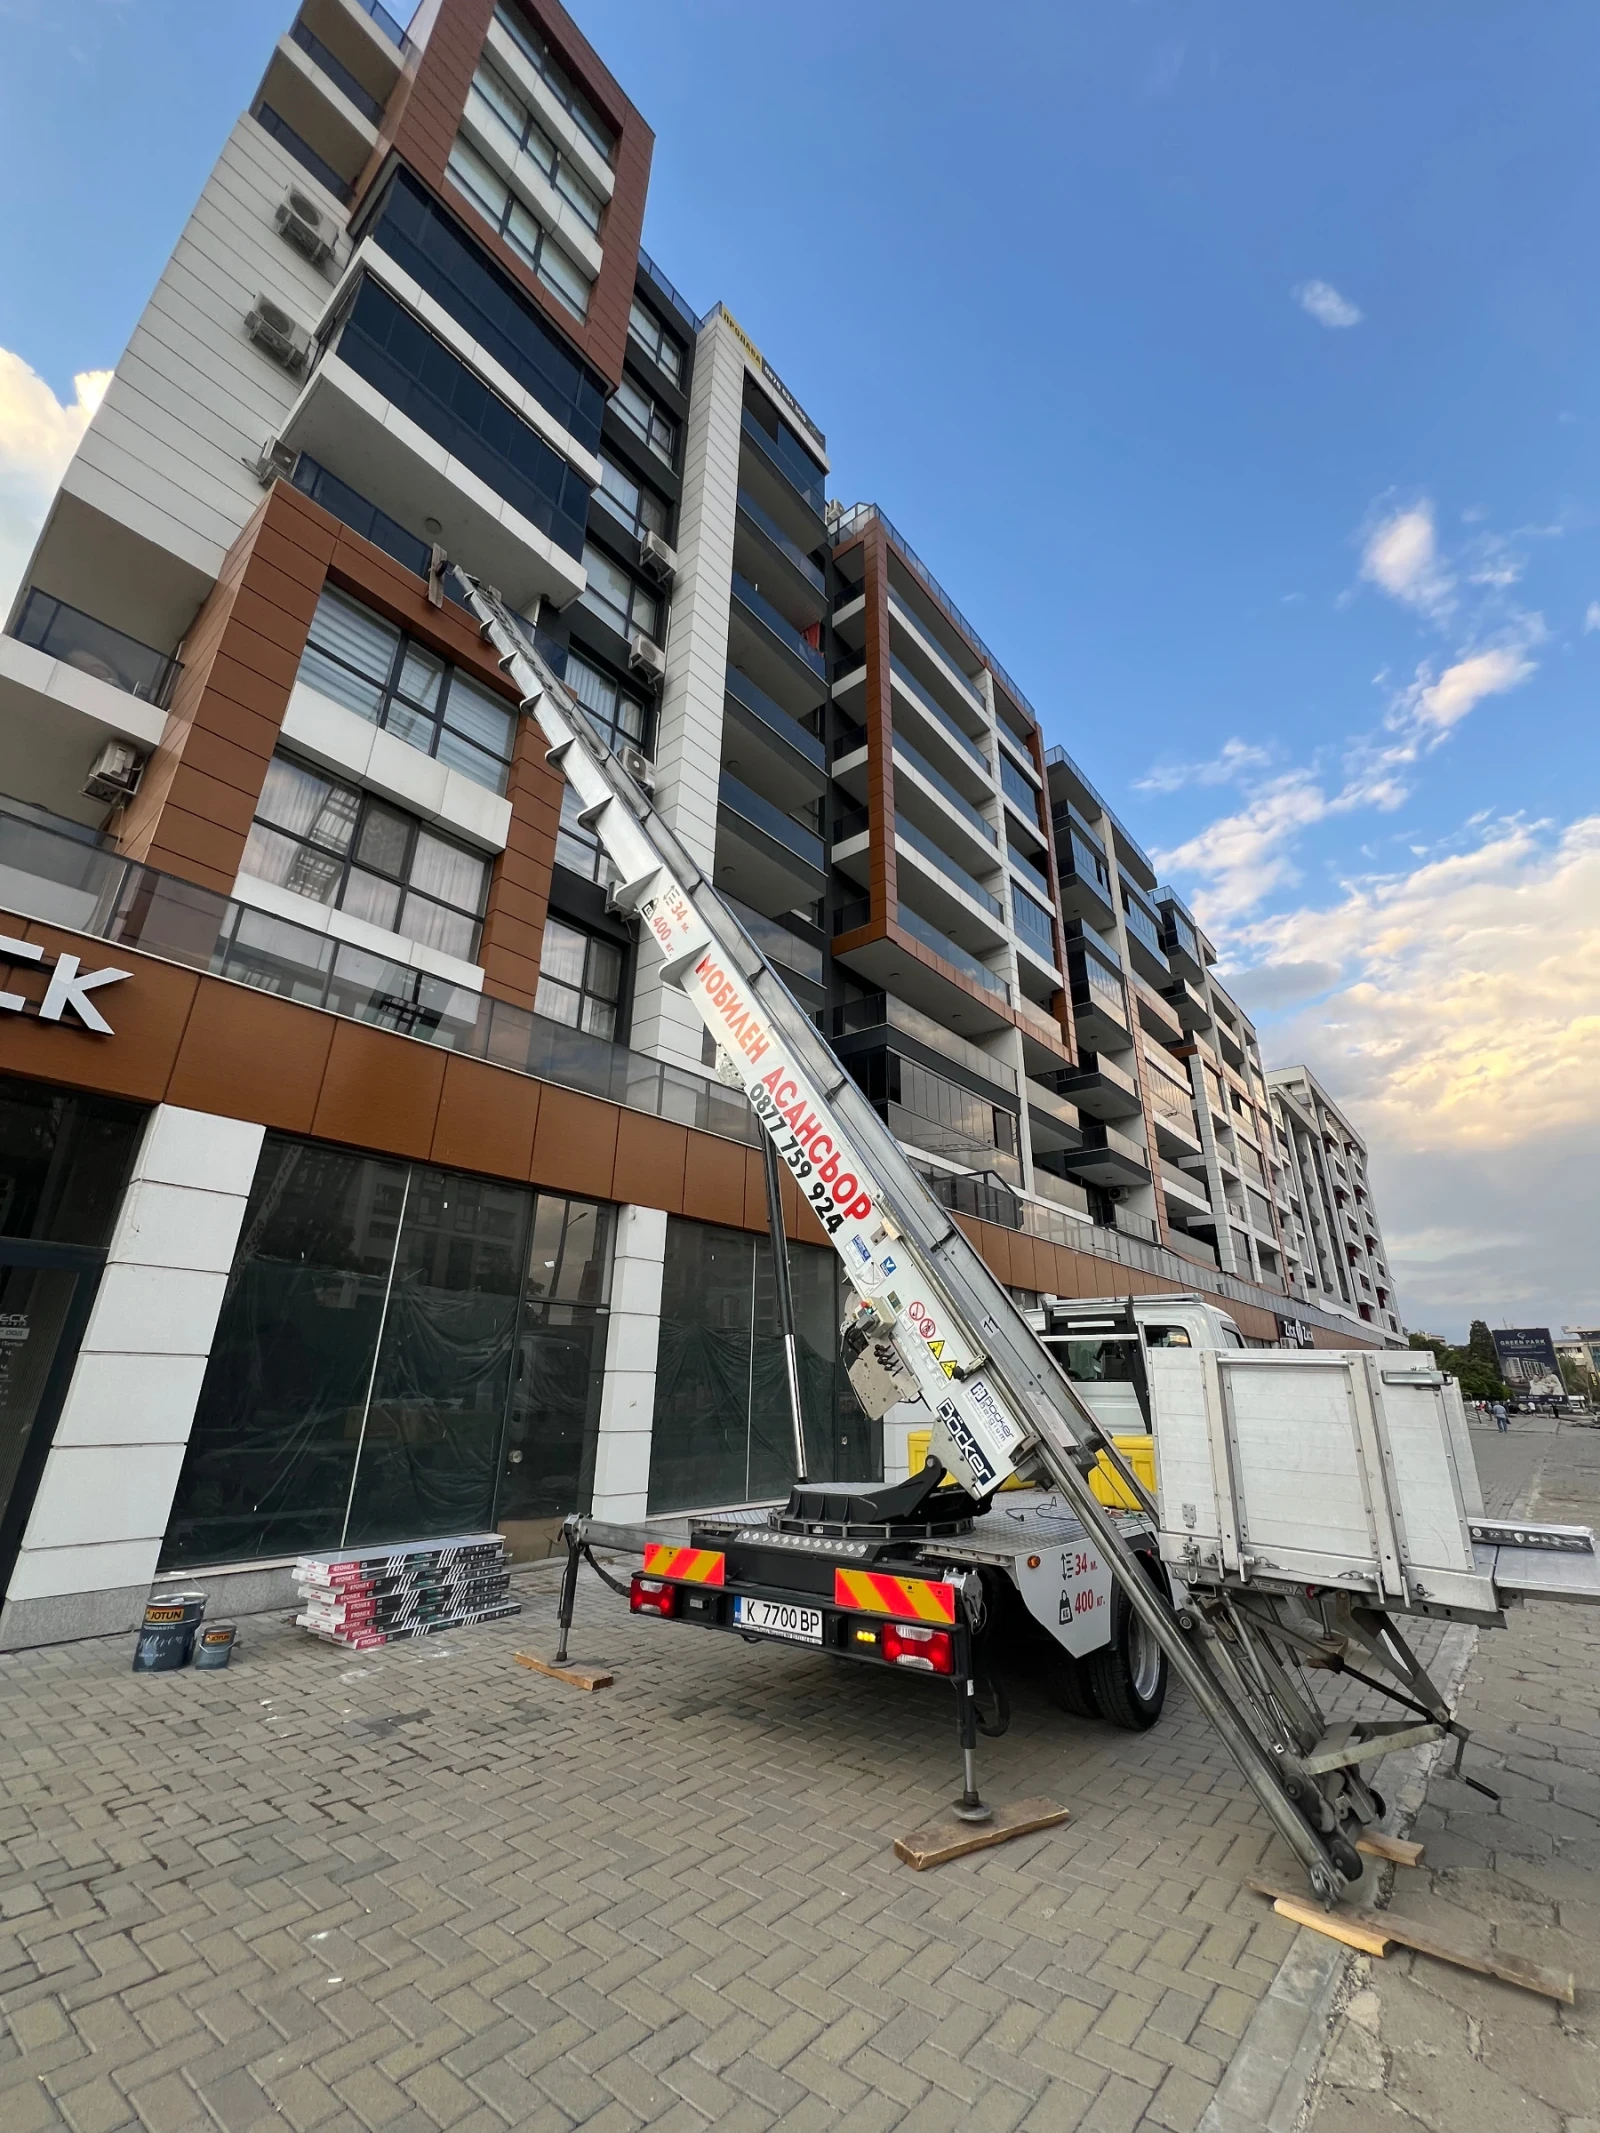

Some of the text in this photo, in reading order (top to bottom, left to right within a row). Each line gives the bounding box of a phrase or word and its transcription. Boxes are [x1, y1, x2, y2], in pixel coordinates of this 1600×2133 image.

[671, 901, 688, 921] 34
[653, 916, 672, 941] 400
[695, 953, 872, 1220] МОБИЛЕН АСАНСЬОР
[750, 1082, 845, 1234] 0877 759 924
[984, 1316, 999, 1333] 11
[937, 1399, 992, 1479] Böcker
[333, 1564, 355, 1572] STONEX
[1075, 1552, 1087, 1576] 34
[335, 1574, 355, 1583] STONEX
[1075, 1589, 1094, 1614] 400
[151, 1611, 182, 1620] JOTUN
[747, 1600, 820, 1633] K 7700 BP
